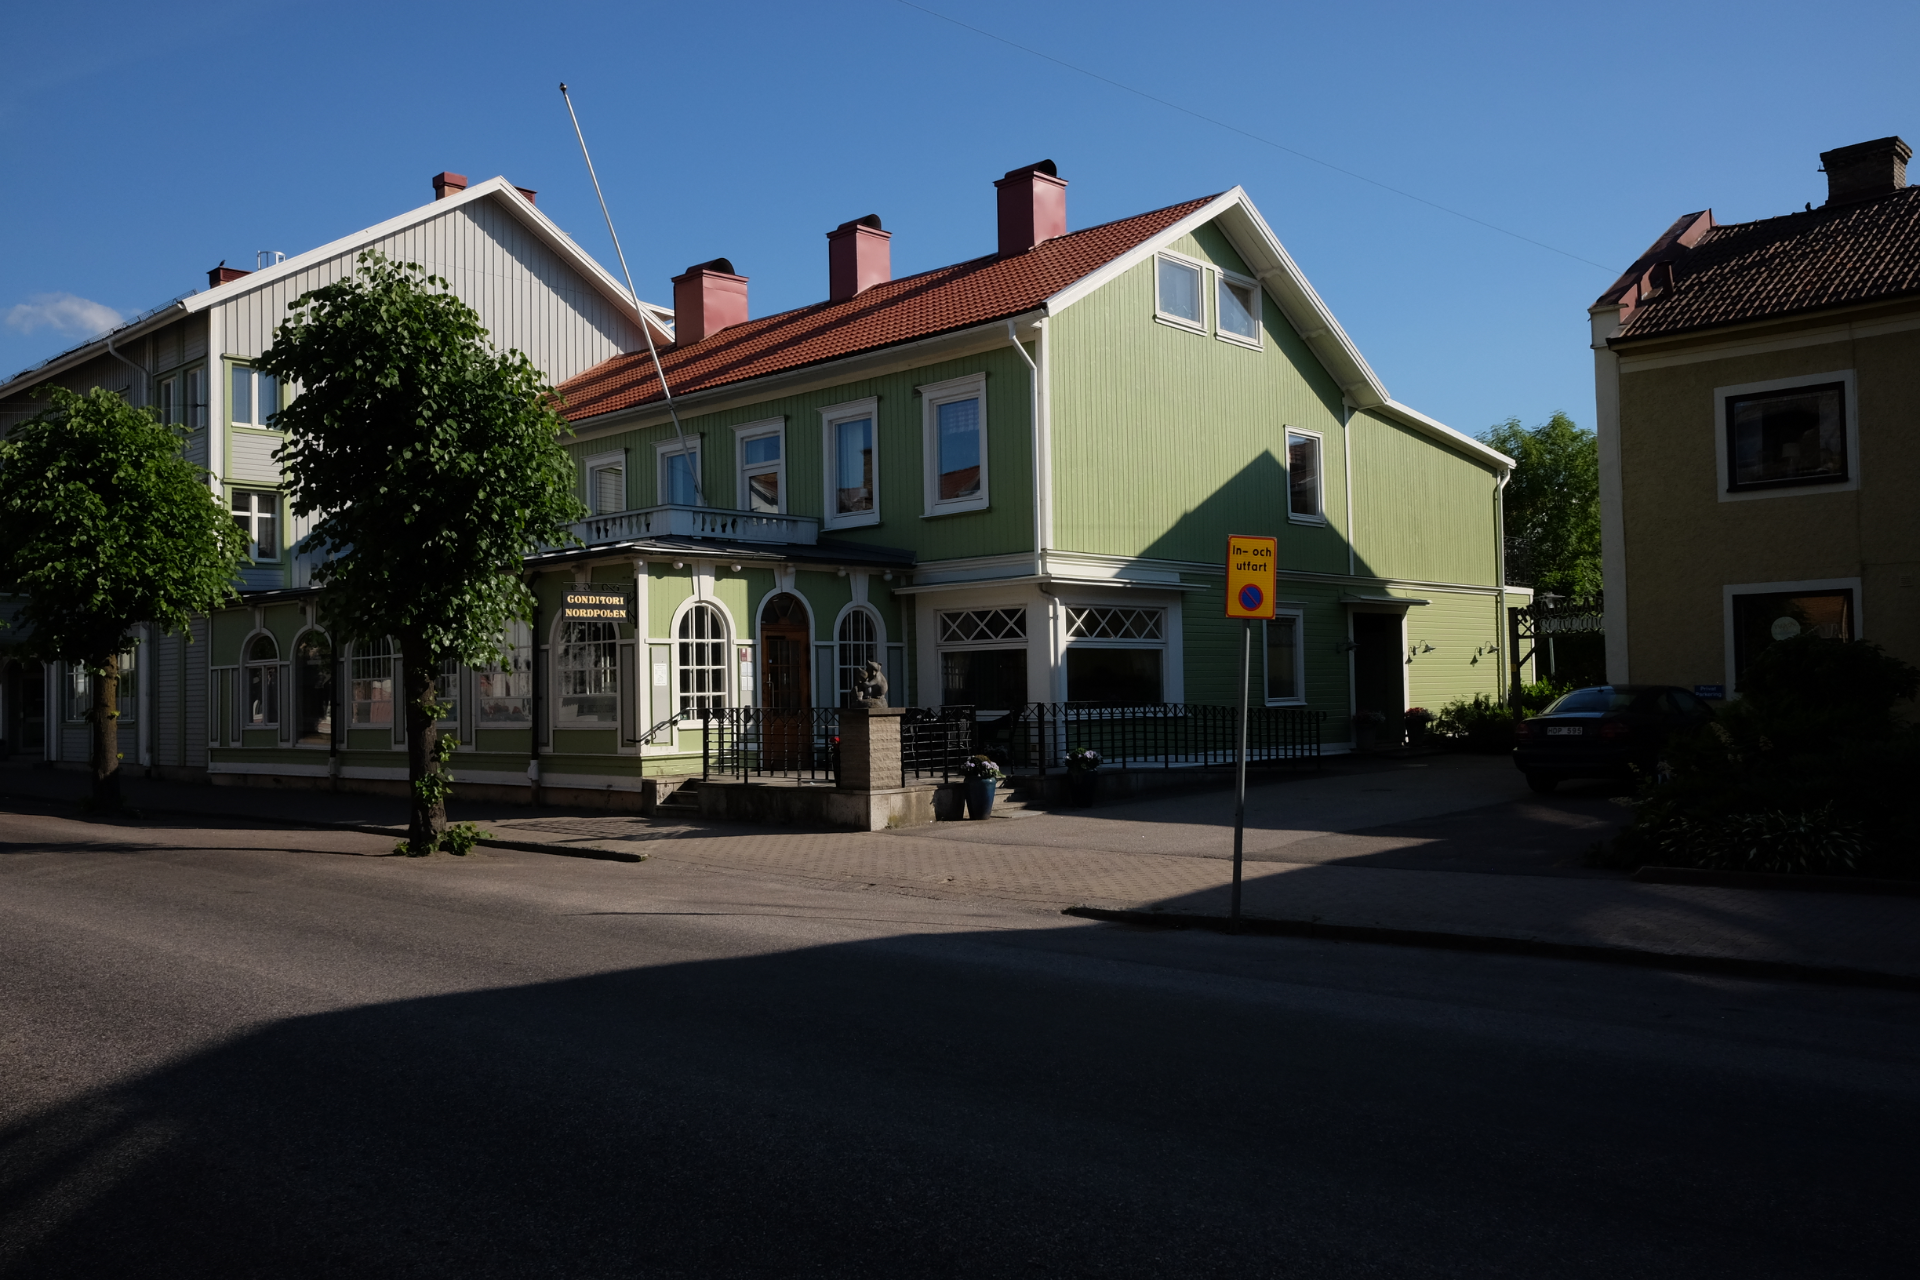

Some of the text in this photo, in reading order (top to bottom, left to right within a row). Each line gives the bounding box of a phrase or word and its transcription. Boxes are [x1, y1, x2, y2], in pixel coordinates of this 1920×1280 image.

[1232, 545, 1272, 557] In- och
[1236, 561, 1267, 572] utfart
[565, 608, 626, 618] NORDPOLEN
